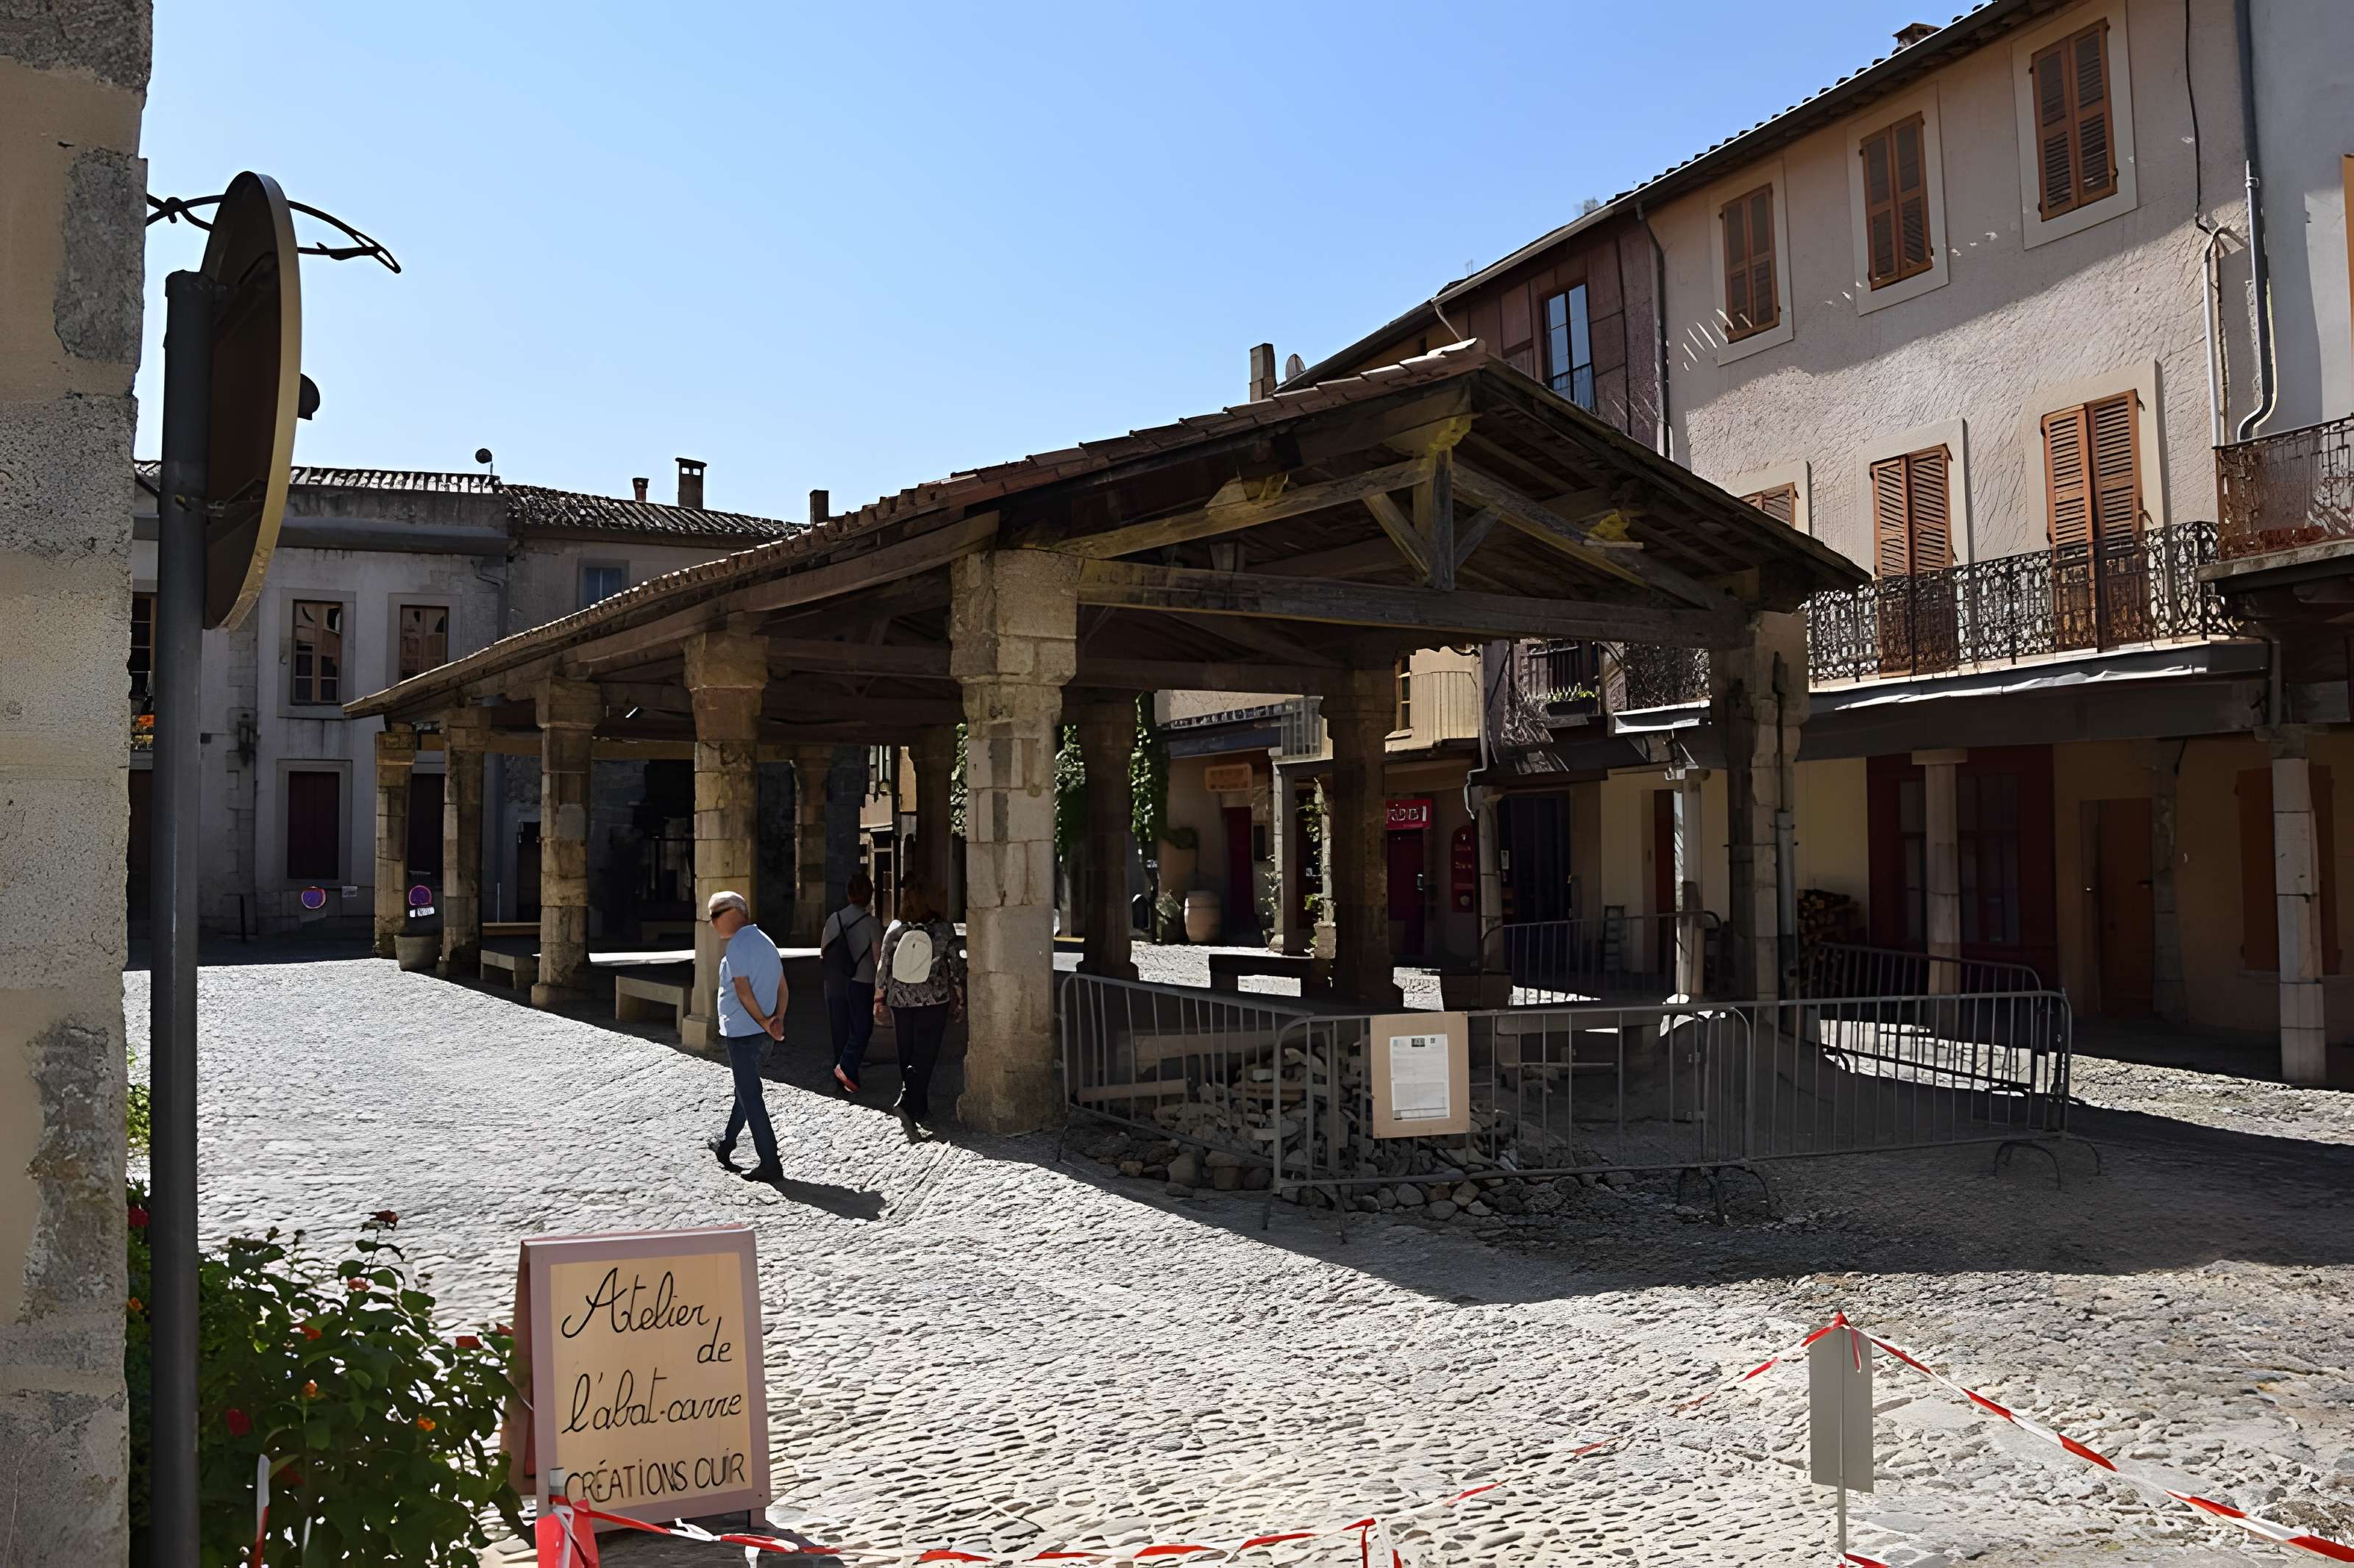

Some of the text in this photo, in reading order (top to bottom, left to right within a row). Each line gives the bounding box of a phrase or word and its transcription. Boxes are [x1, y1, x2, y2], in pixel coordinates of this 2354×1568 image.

[561, 1267, 710, 1338] Atelier
[697, 1316, 732, 1364] de
[564, 1459, 688, 1505] CRÉATIONS
